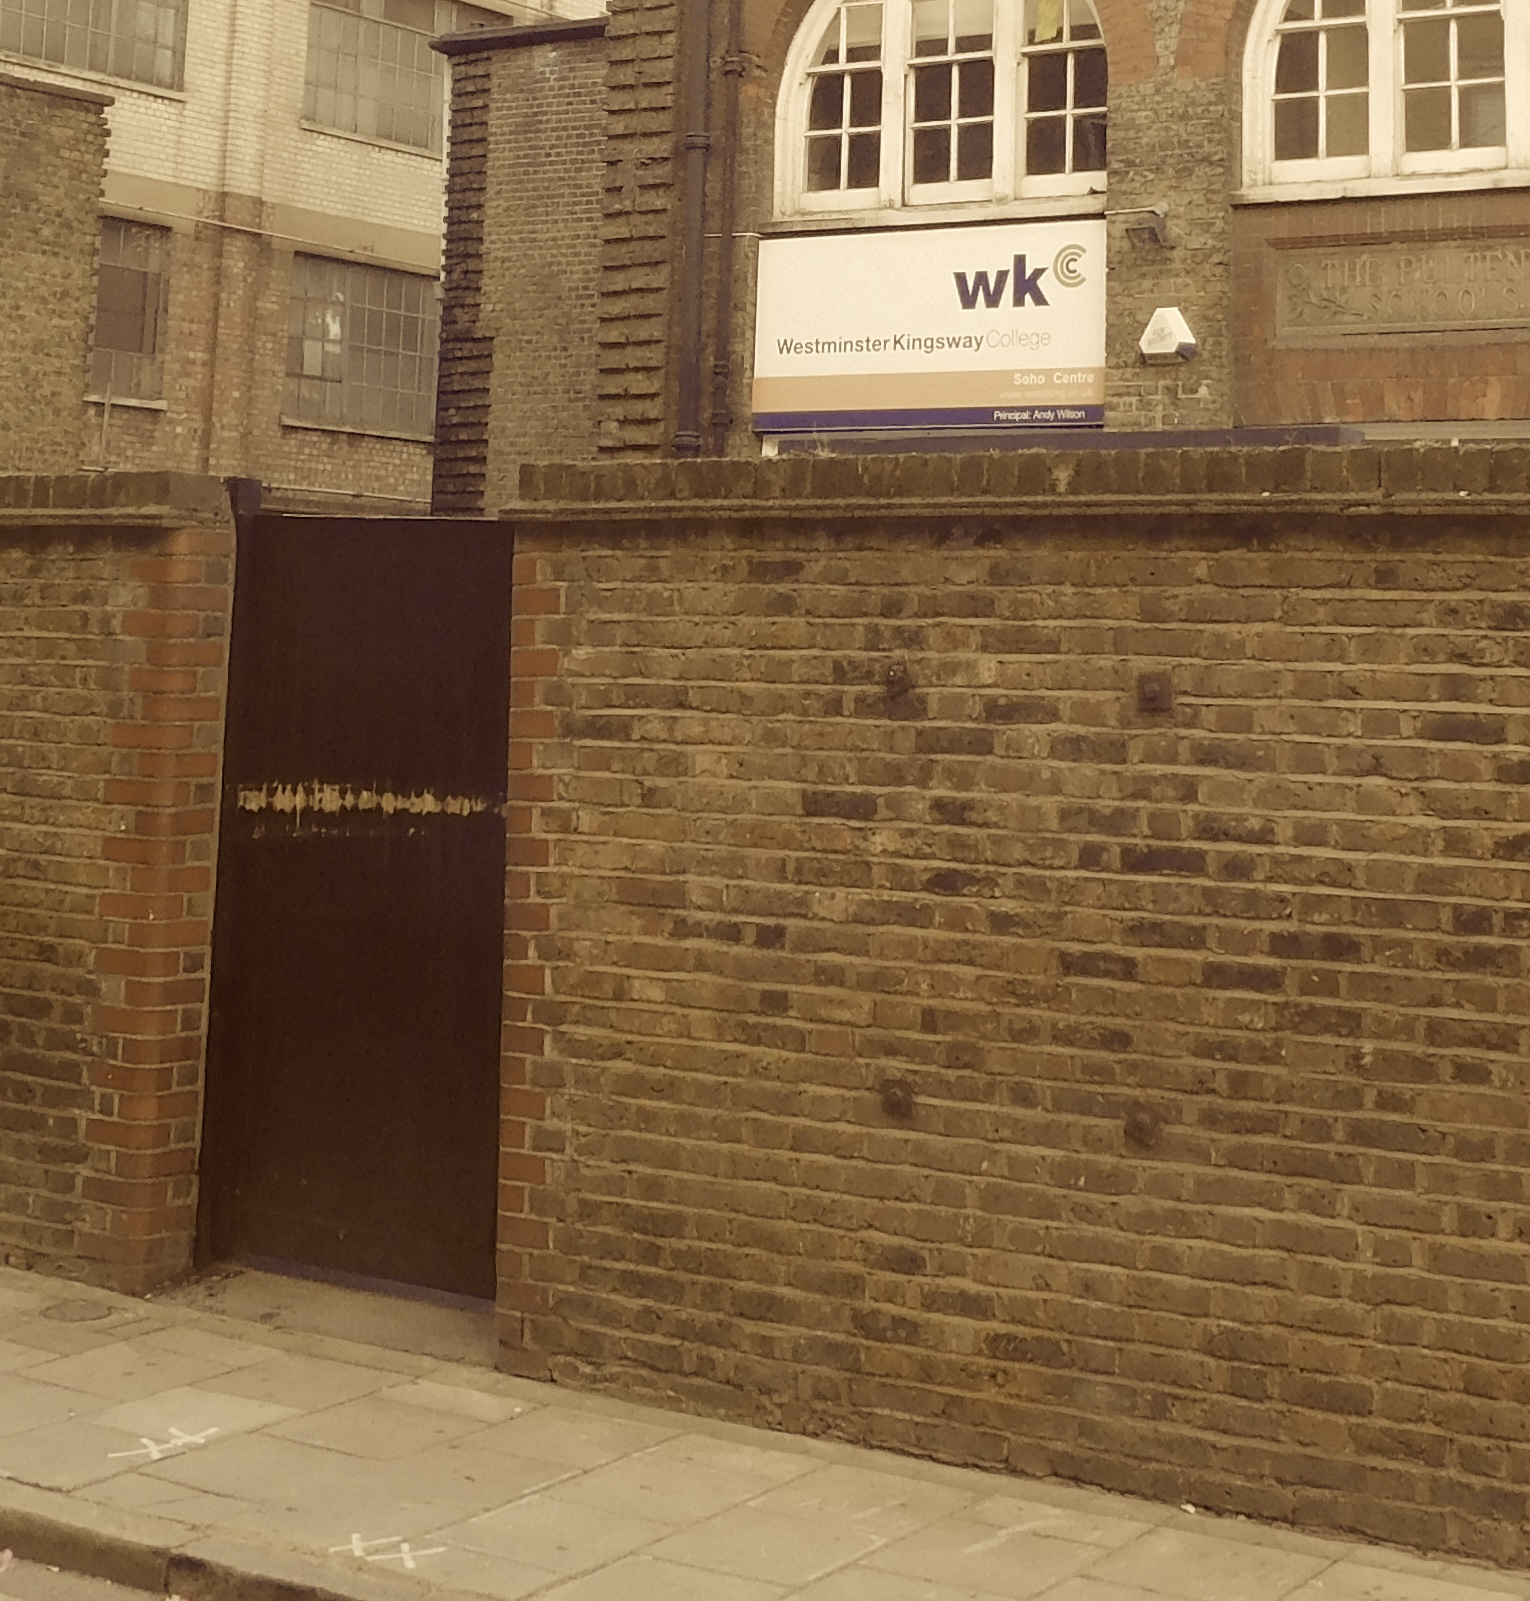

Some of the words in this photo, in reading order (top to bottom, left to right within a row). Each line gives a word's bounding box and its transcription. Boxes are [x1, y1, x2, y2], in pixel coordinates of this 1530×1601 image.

[986, 329, 1051, 351] College
[1013, 373, 1046, 385] Soho
[1053, 371, 1095, 384] Centre
[1032, 409, 1055, 422] Andy
[1056, 408, 1086, 420] Wilson
